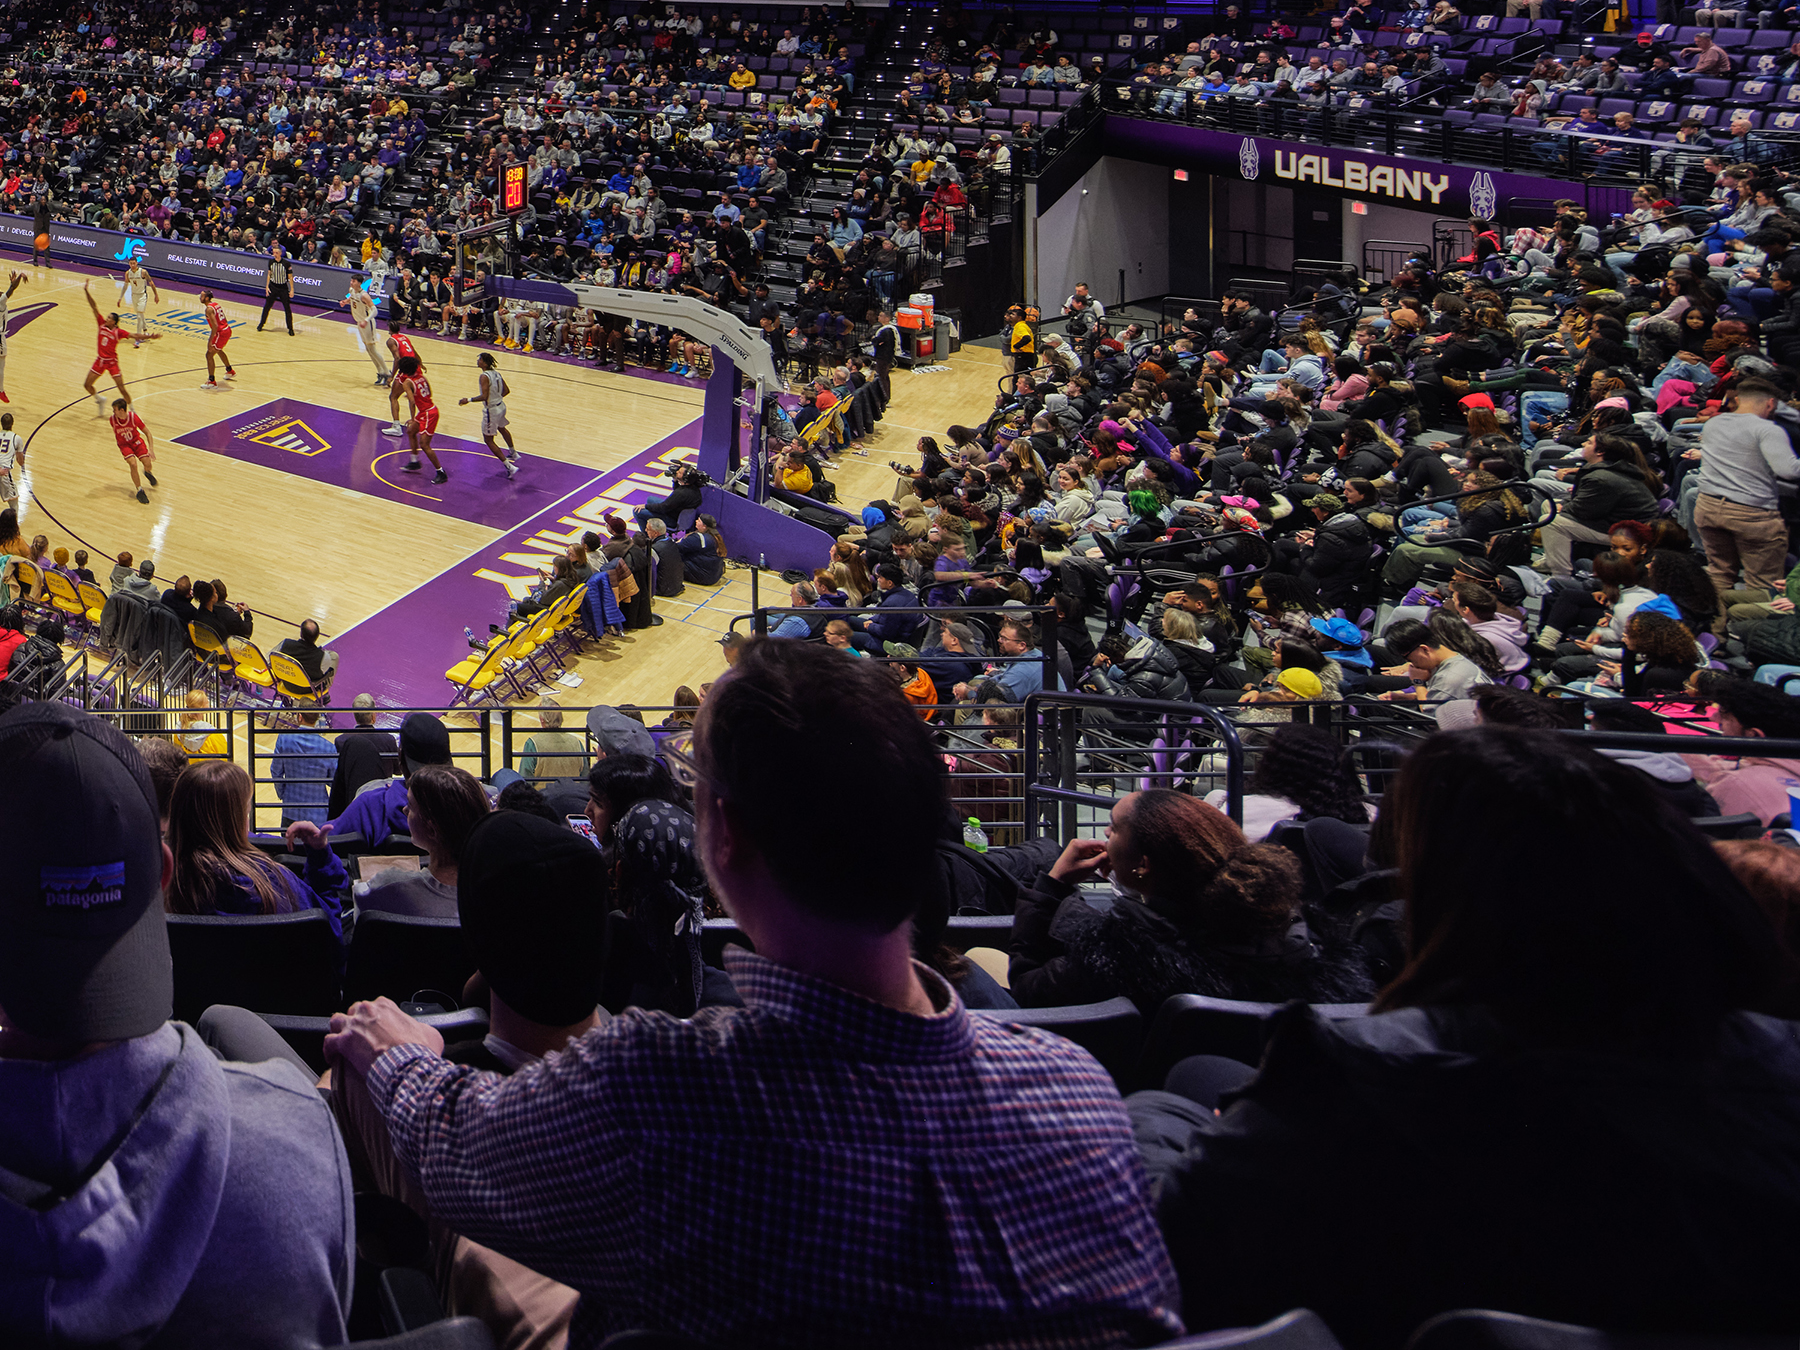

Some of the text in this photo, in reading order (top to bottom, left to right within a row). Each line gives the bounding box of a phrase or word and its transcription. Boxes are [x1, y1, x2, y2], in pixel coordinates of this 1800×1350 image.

[1275, 150, 1449, 204] UALBANY
[507, 182, 521, 207] 20
[57, 235, 97, 248] MANAGEMENT
[114, 237, 146, 263] JC
[167, 253, 184, 263] REAL
[184, 257, 208, 267] ESTATE
[216, 262, 265, 277] DEVELOPMENT
[402, 340, 412, 353] 3
[718, 334, 749, 361] SPALDING
[274, 660, 294, 671] GREAT
[275, 665, 296, 677] DANES
[46, 887, 122, 909] patagonia
